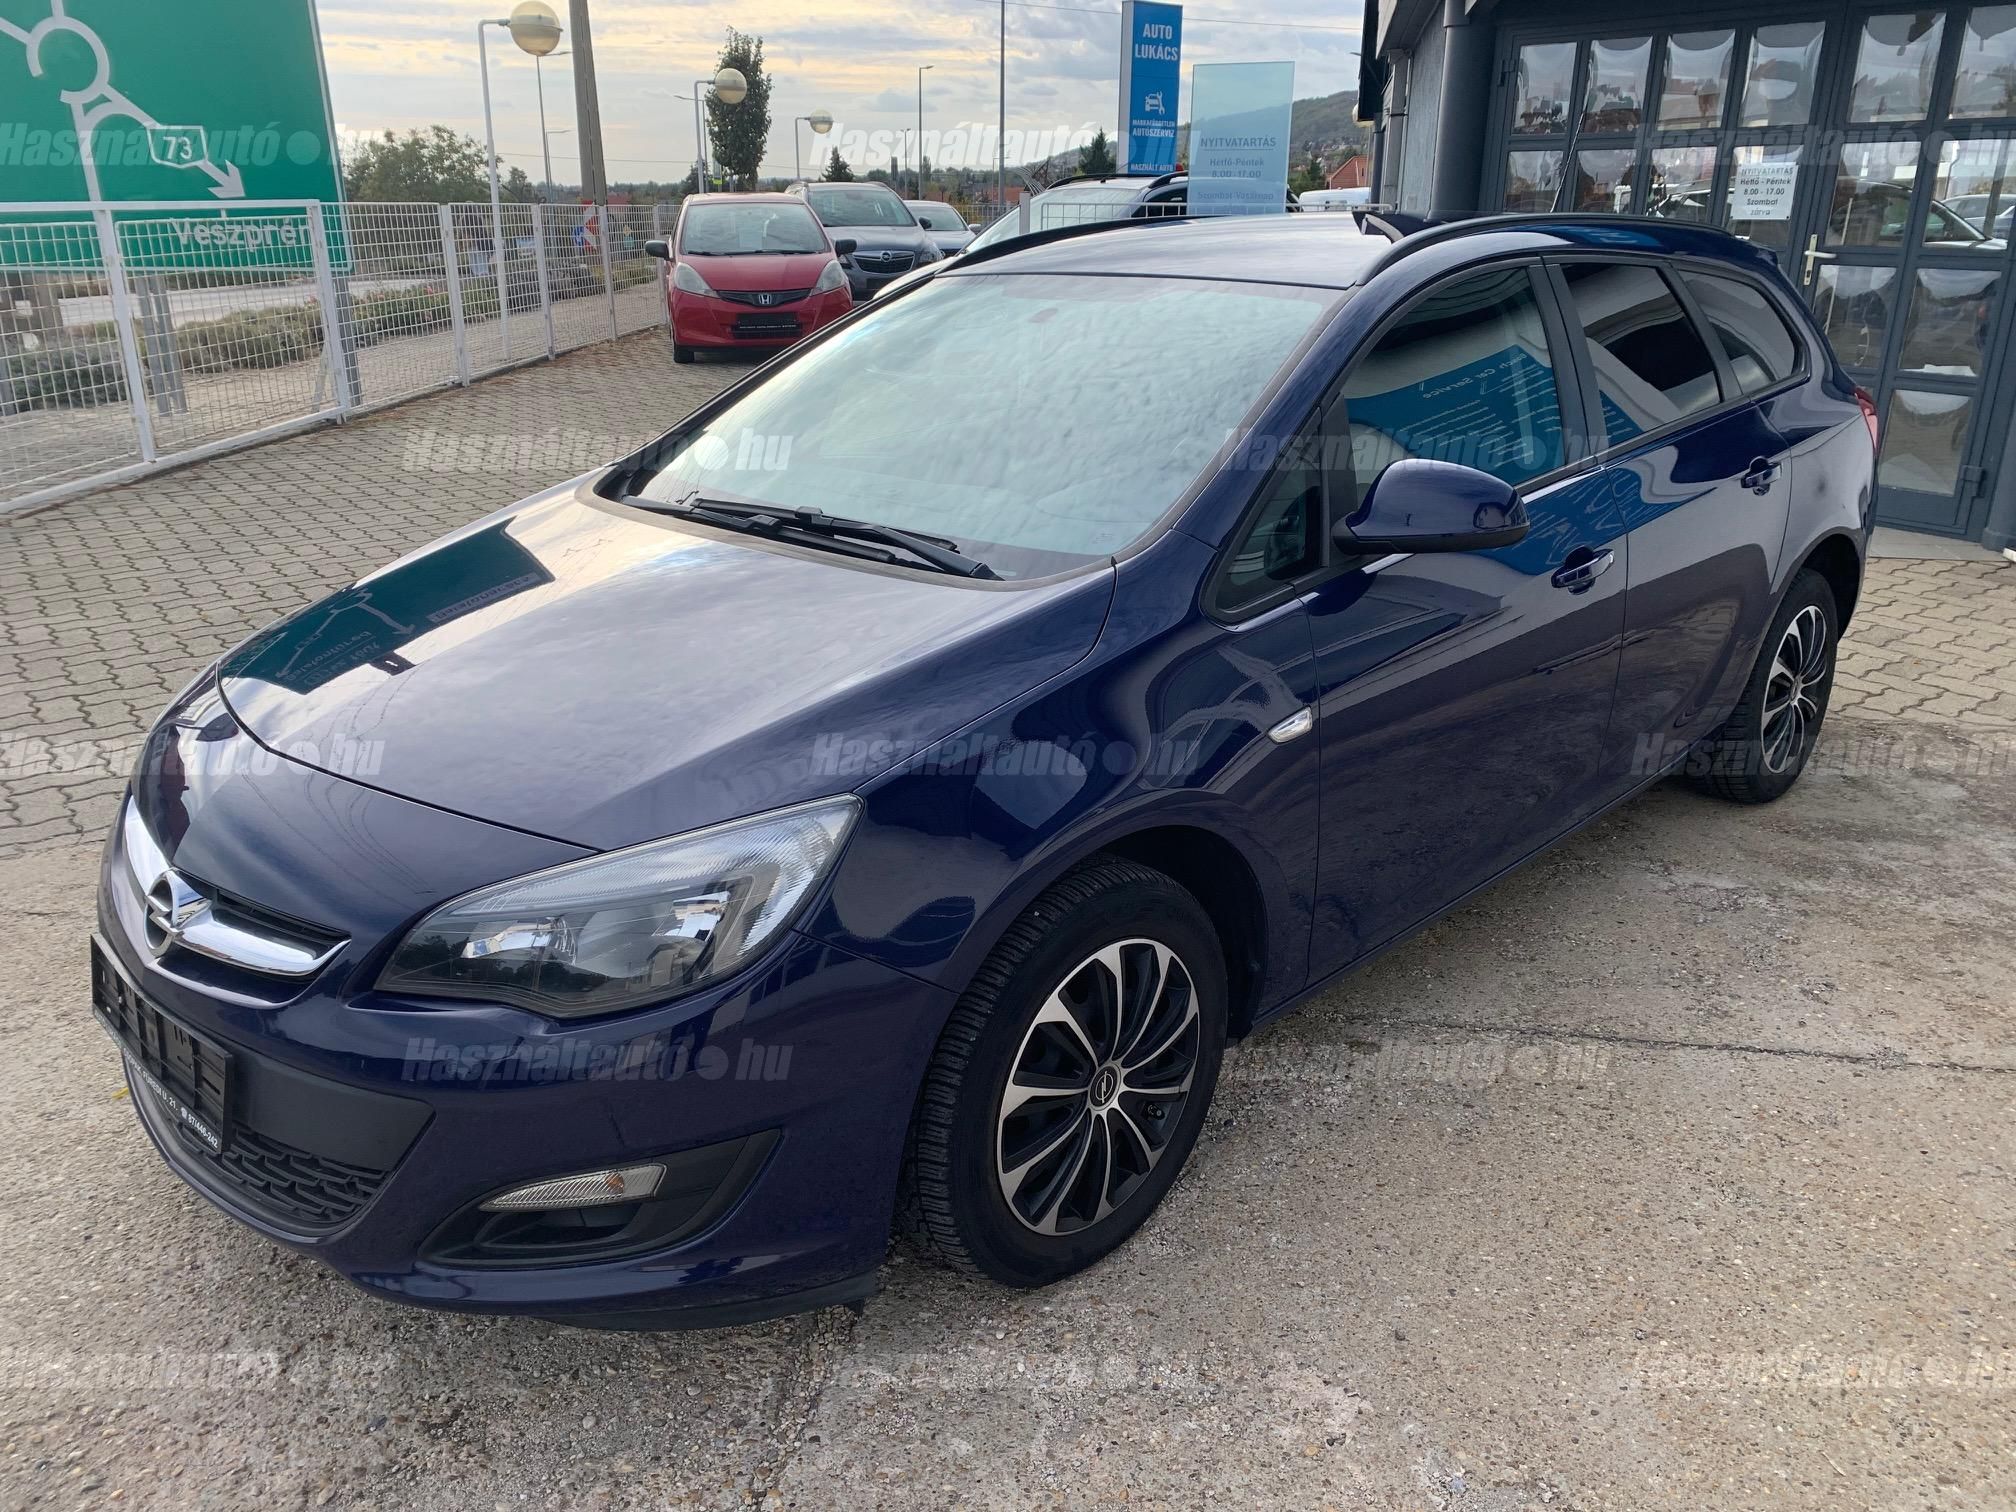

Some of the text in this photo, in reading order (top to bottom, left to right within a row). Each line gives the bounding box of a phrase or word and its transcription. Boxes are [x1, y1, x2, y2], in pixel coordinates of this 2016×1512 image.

[1143, 23, 1173, 40] AUTO
[1135, 43, 1178, 61] LUKÁCS
[162, 136, 193, 160] 73
[1200, 135, 1277, 148] NYITVATARTÁS
[1743, 188, 1759, 196] 8.00
[1766, 188, 1785, 196] 17.00
[1746, 198, 1779, 206] Szombat
